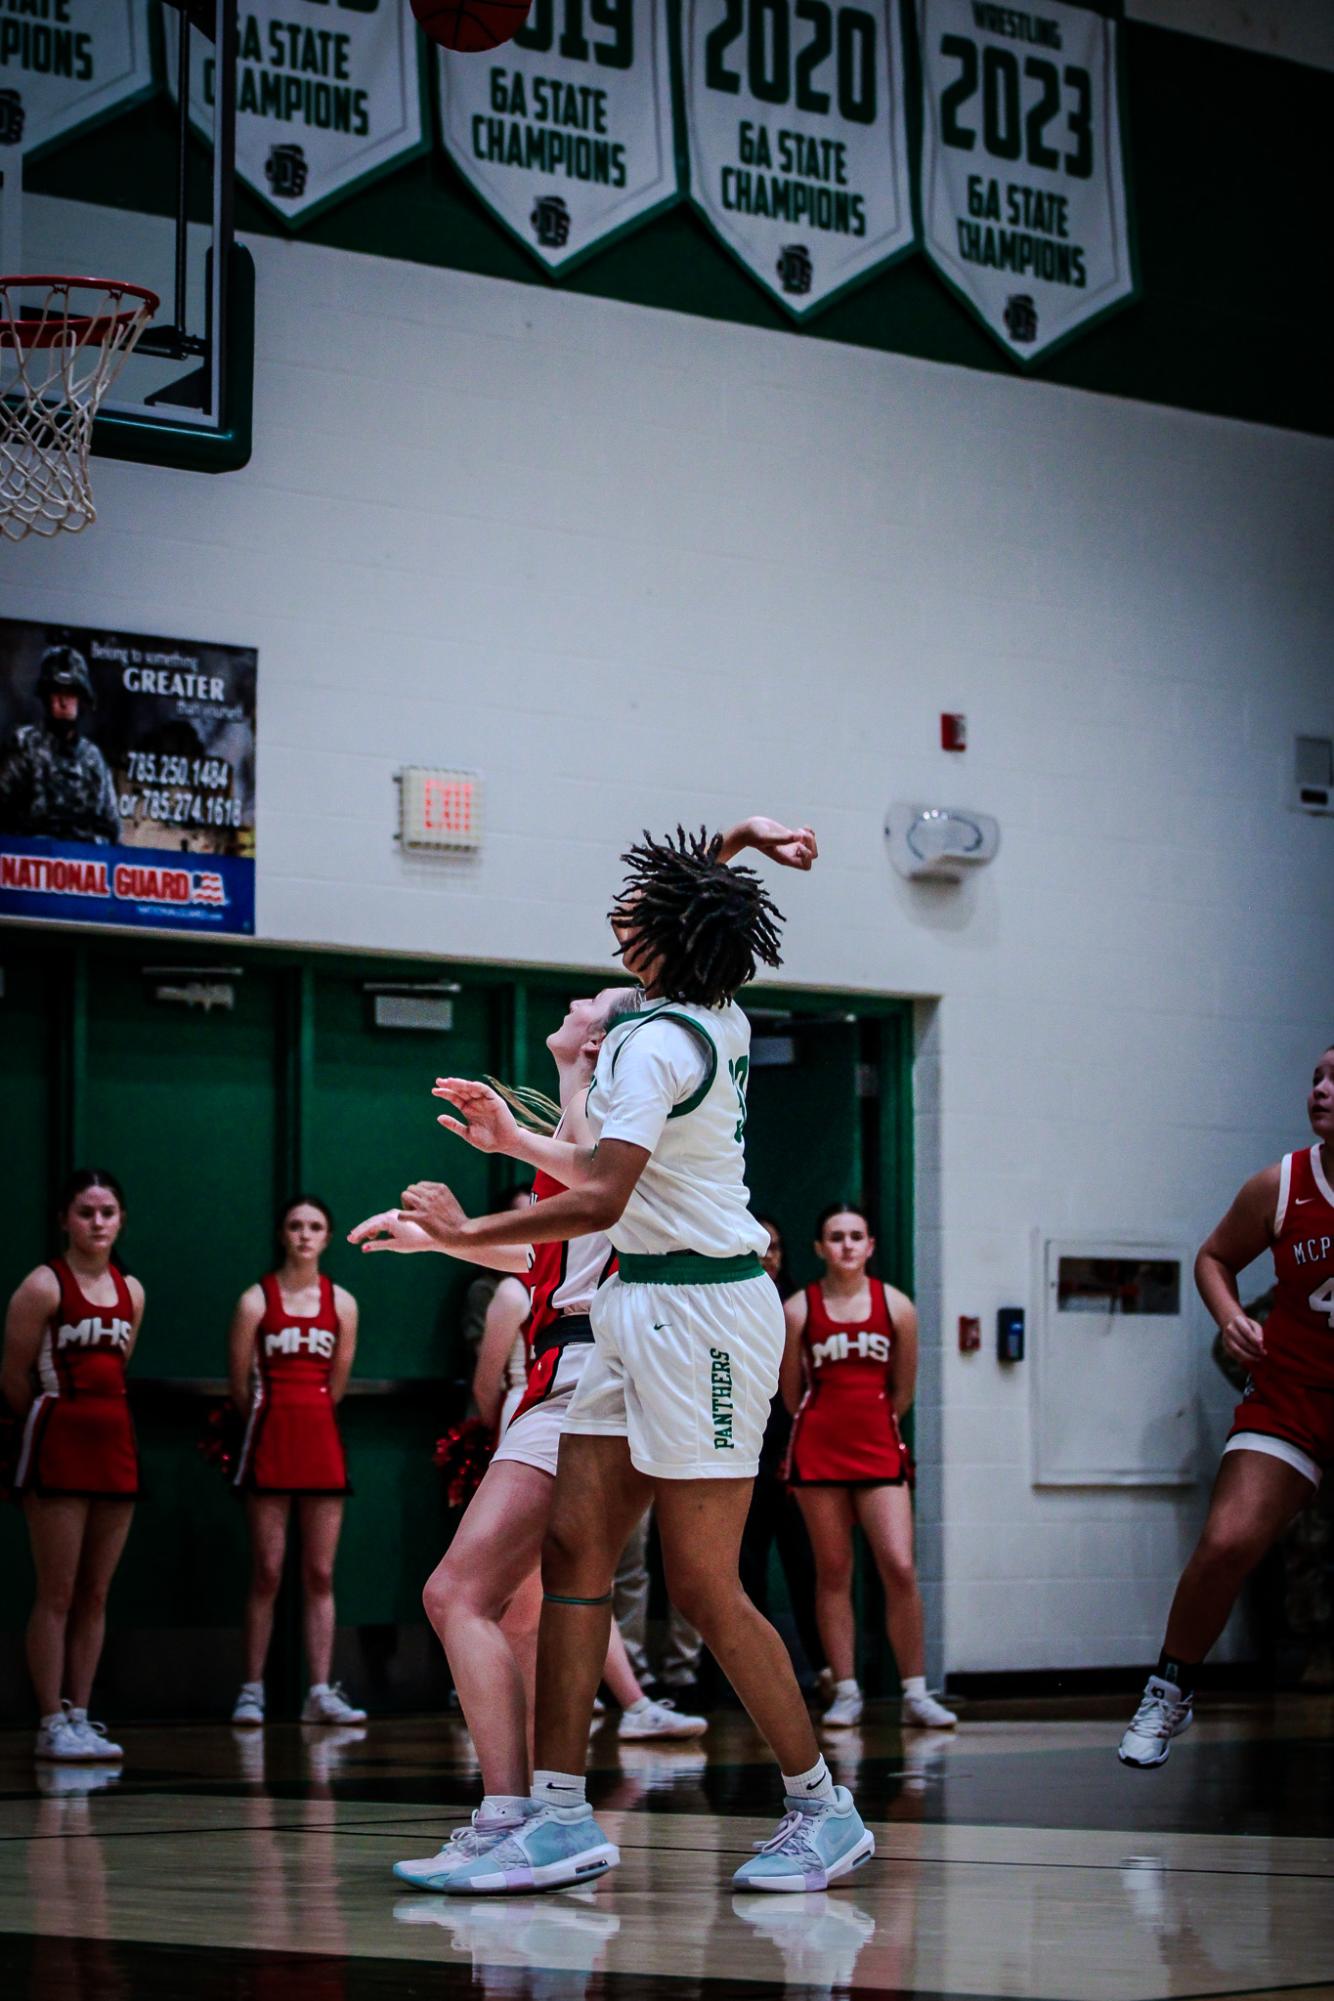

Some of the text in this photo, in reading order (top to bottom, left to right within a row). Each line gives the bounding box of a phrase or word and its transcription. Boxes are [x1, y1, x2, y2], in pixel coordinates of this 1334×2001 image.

[235, 11, 350, 80] A STATE
[973, 2, 1062, 50] WRESTLING
[705, 0, 877, 125] 2020
[203, 58, 369, 136] CAMPIONS
[490, 67, 608, 134] 6A STATE
[940, 35, 1093, 179] 2023
[472, 115, 626, 188] CHAMPIONS
[738, 121, 848, 185] 6A STATE
[721, 166, 866, 237] CHAMPIONS
[966, 174, 1069, 238] 6A STATE
[956, 218, 1087, 288] CHAMPIONS
[122, 667, 225, 702] GREATER
[119, 793, 138, 817] or
[0, 854, 190, 902] NATIONAL GUARD
[57, 1315, 133, 1351] MHS
[264, 1325, 336, 1360] MHS
[811, 1330, 891, 1369] MHS
[711, 1346, 735, 1450] PANTHERS
